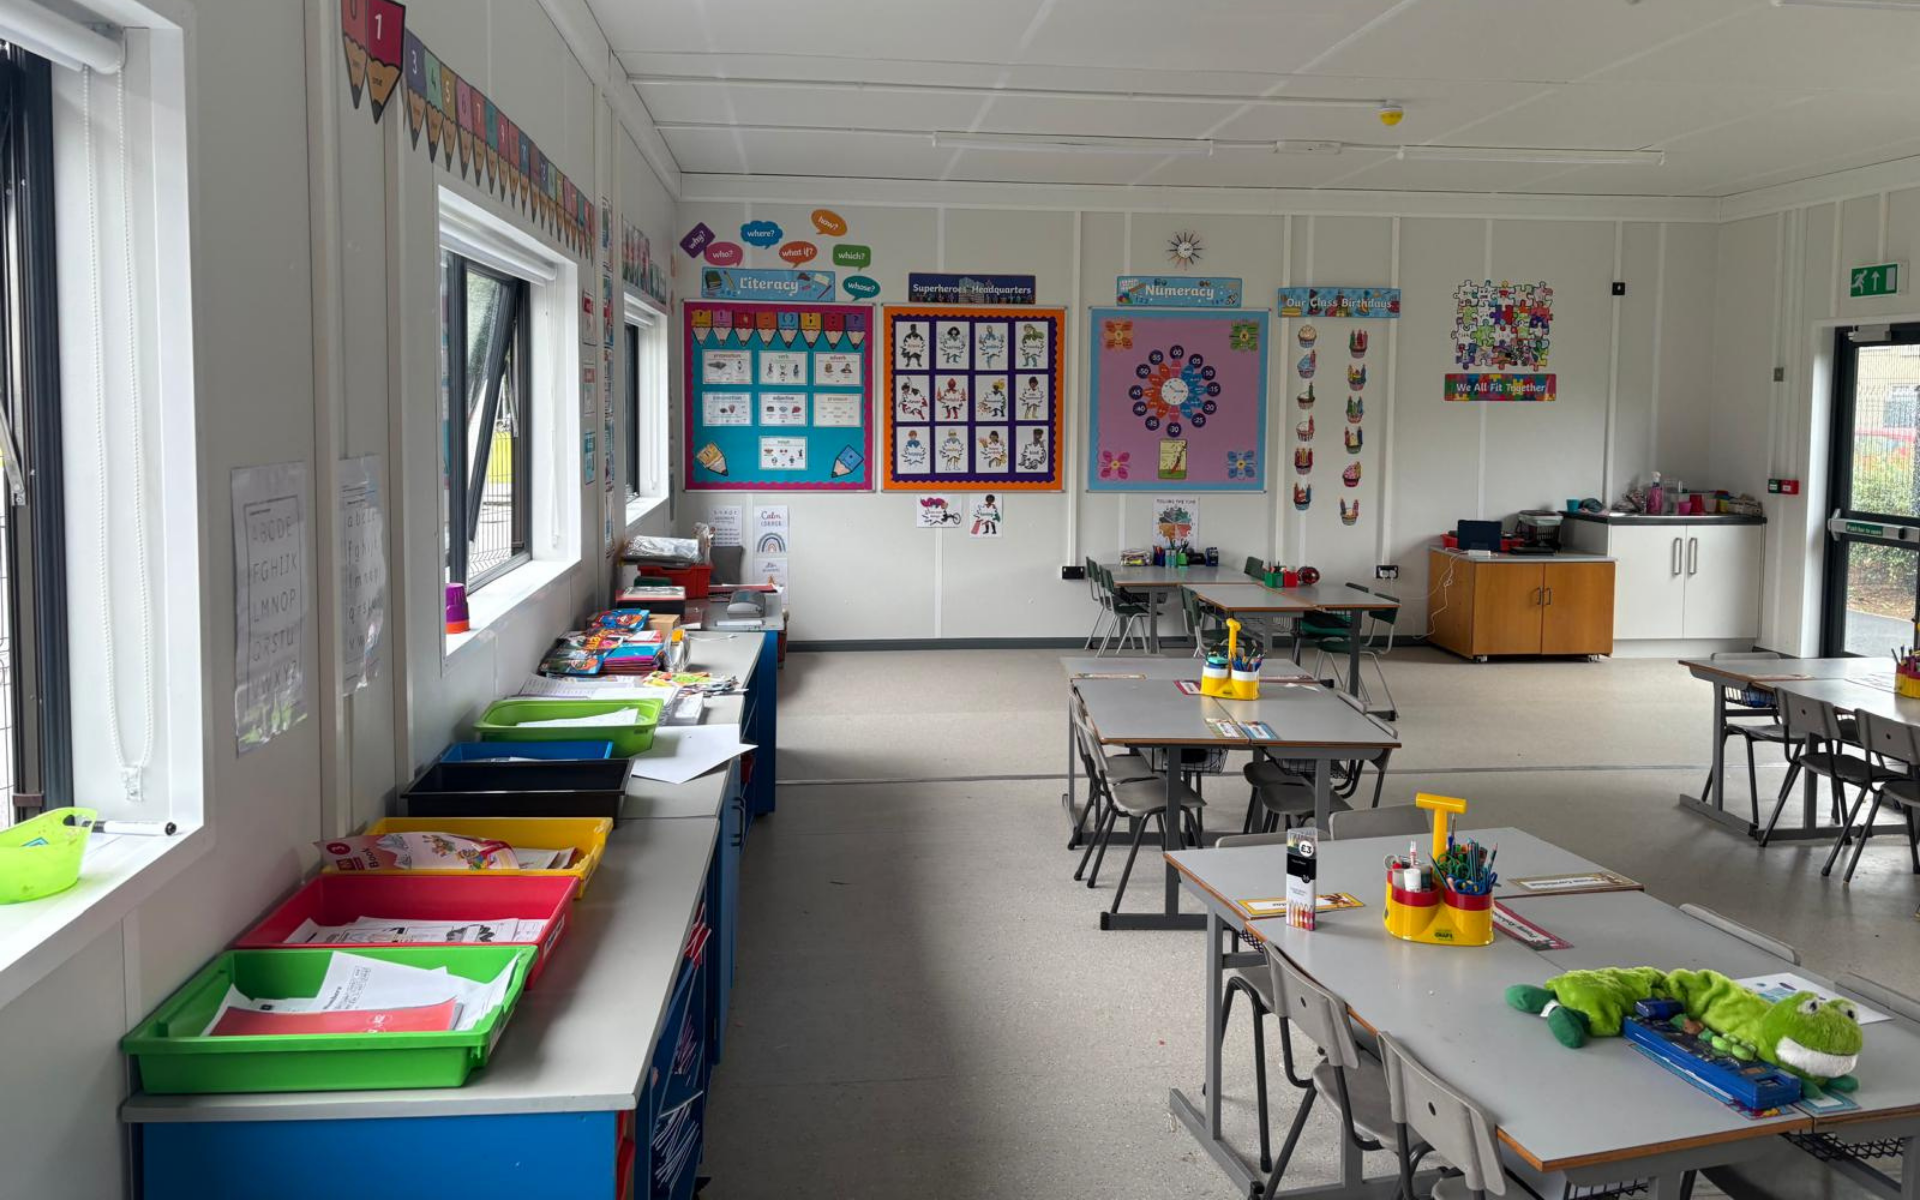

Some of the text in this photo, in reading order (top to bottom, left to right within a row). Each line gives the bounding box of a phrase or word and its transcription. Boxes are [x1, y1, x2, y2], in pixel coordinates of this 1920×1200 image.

[374, 13, 383, 40] 1
[412, 49, 418, 75] 3
[431, 68, 437, 92] 4
[818, 216, 839, 230] how?
[747, 229, 775, 238] where?
[689, 230, 706, 249] why?
[712, 249, 733, 259] who?
[782, 247, 813, 257] what if?
[838, 252, 865, 260] which?
[739, 277, 799, 293] Literacy
[848, 282, 875, 292] whose?
[971, 286, 1032, 295] Headquarters
[1145, 285, 1215, 299] Numeracy
[1286, 298, 1392, 309] Our Class Birthdays
[1456, 383, 1546, 394] We All Fit Together
[761, 510, 781, 520] Calm
[1301, 844, 1312, 853] £3
[363, 848, 379, 868] Book
